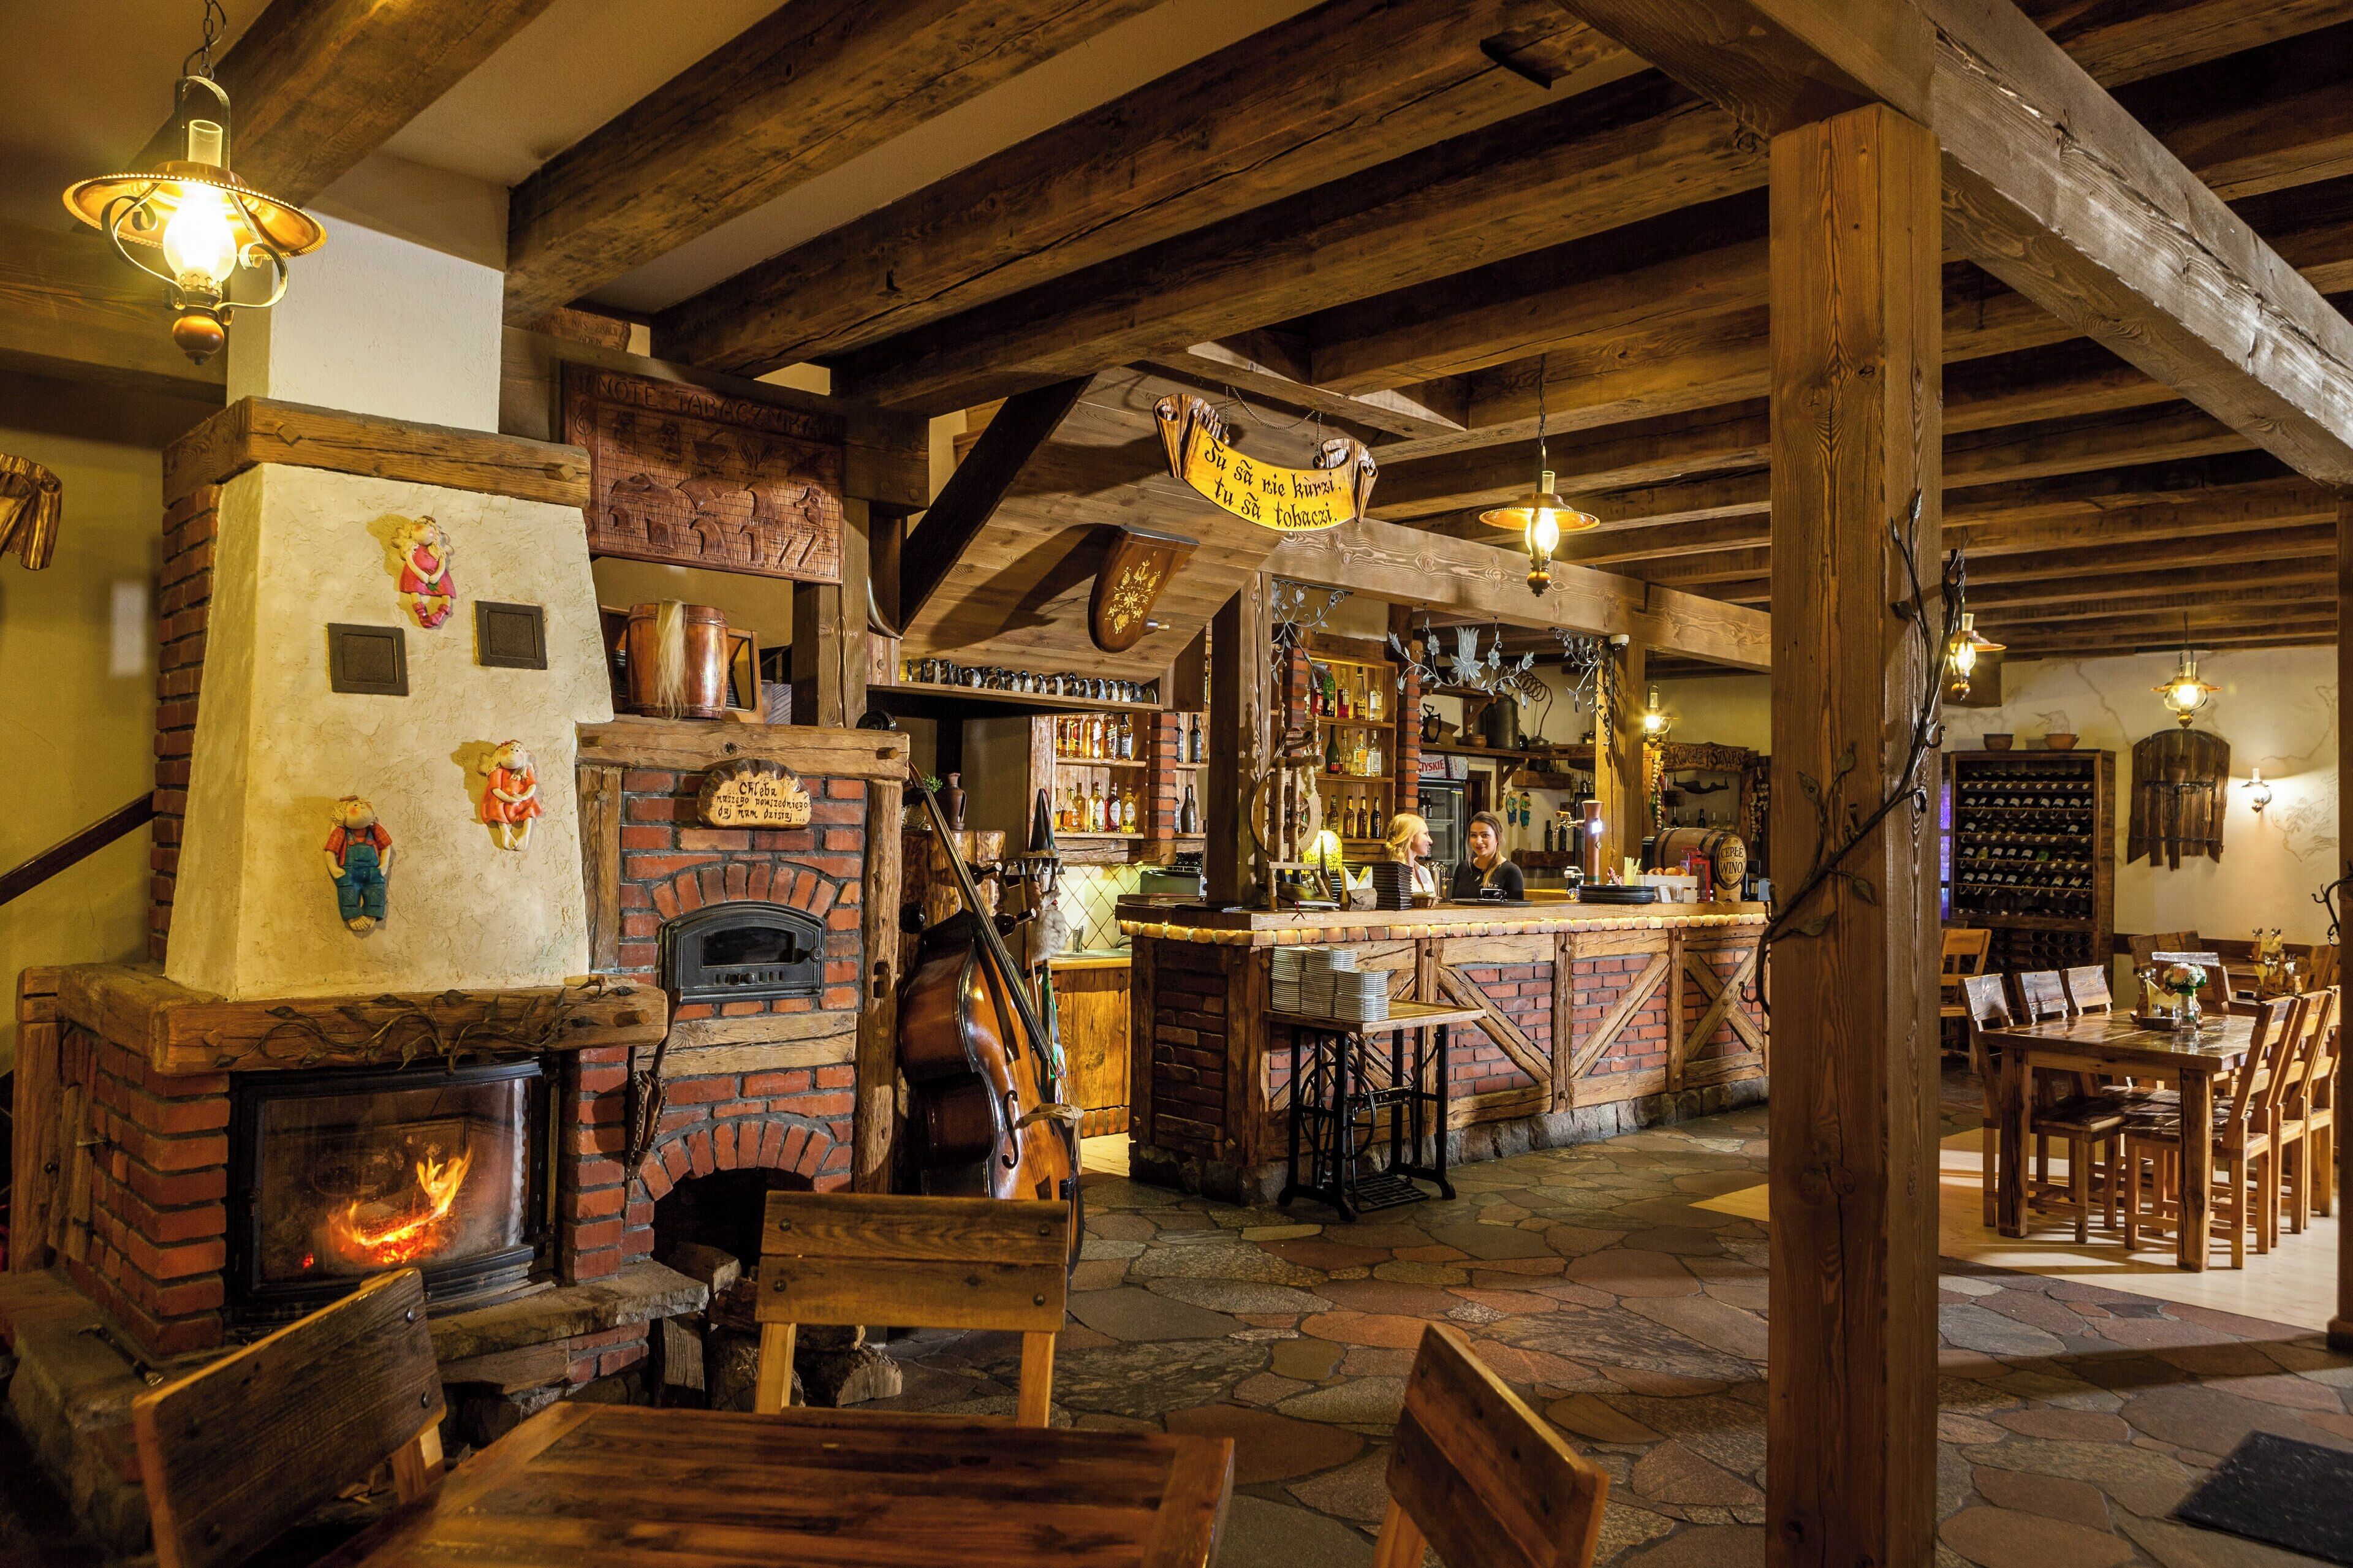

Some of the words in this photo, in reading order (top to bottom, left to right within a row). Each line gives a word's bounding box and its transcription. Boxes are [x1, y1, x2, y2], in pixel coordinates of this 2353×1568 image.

[1214, 475, 1233, 506] tu
[1262, 473, 1286, 497] nie
[1419, 760, 1444, 772] TYSKIE
[716, 795, 749, 807] naszego
[756, 797, 808, 811] powszedniego
[718, 805, 731, 819] daj
[738, 809, 758, 819] nam
[1720, 862, 1743, 874] WINO
